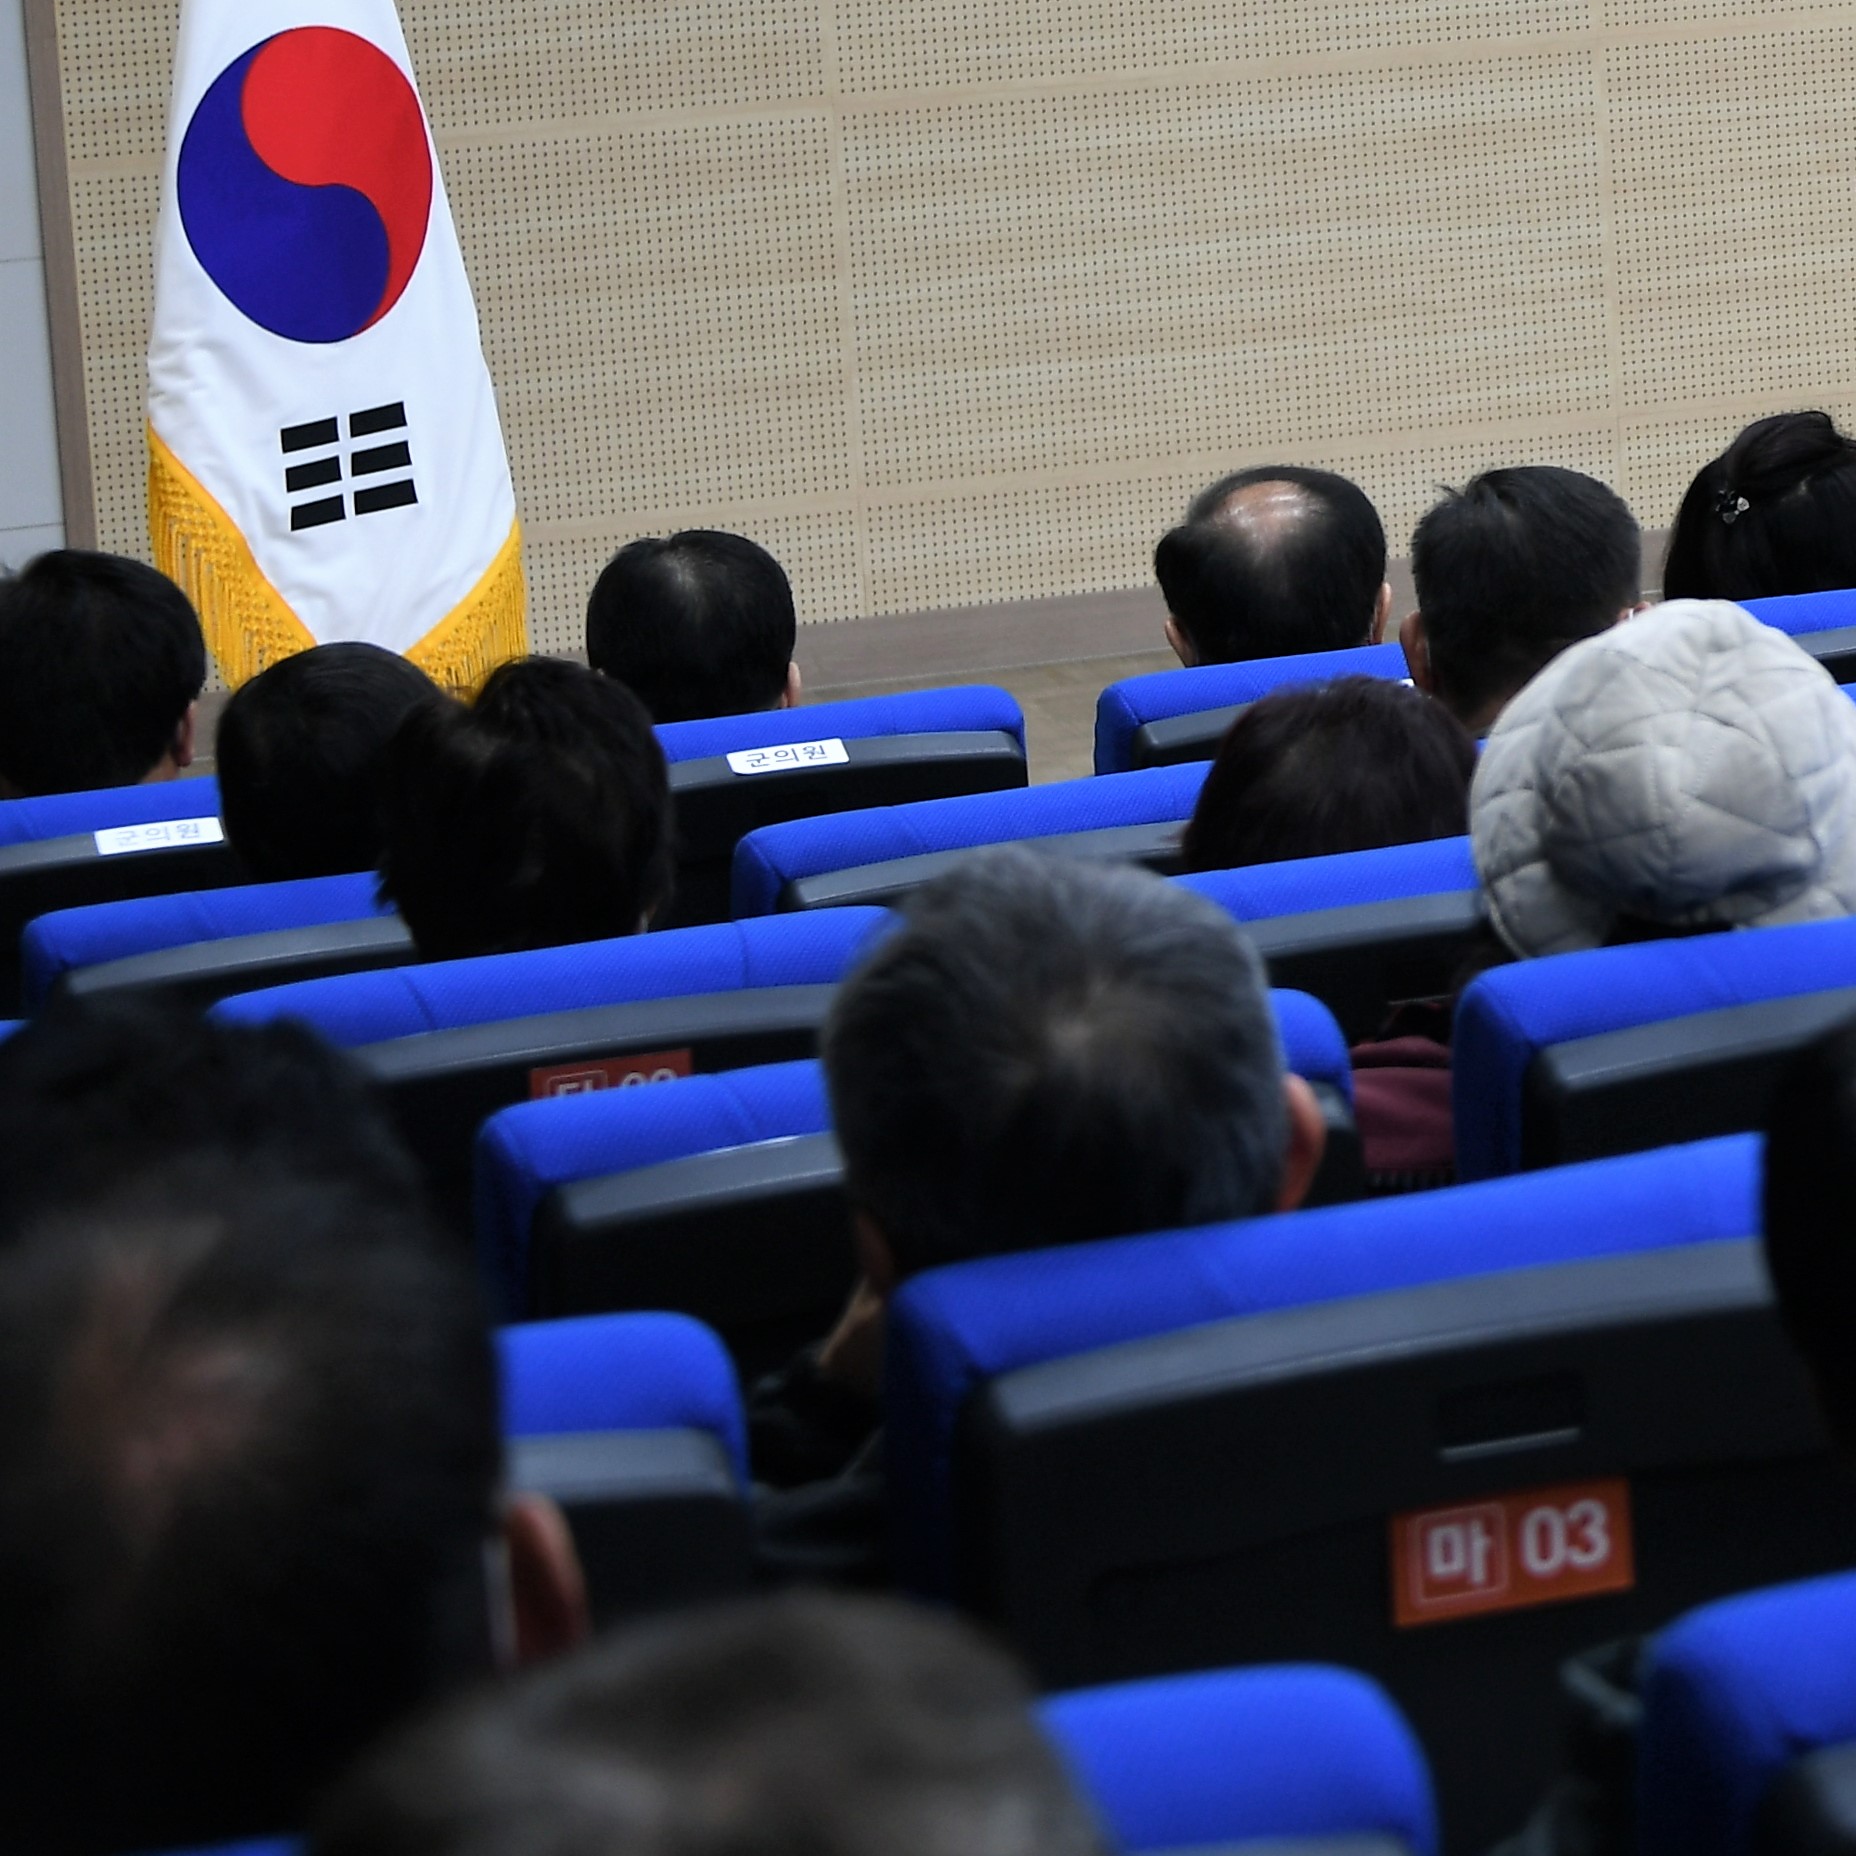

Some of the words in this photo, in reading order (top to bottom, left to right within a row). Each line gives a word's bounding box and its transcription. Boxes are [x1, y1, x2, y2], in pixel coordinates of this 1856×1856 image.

[745, 744, 828, 768] 군의원
[1427, 1519, 1491, 1584] 마
[1521, 1498, 1610, 1576] 03
